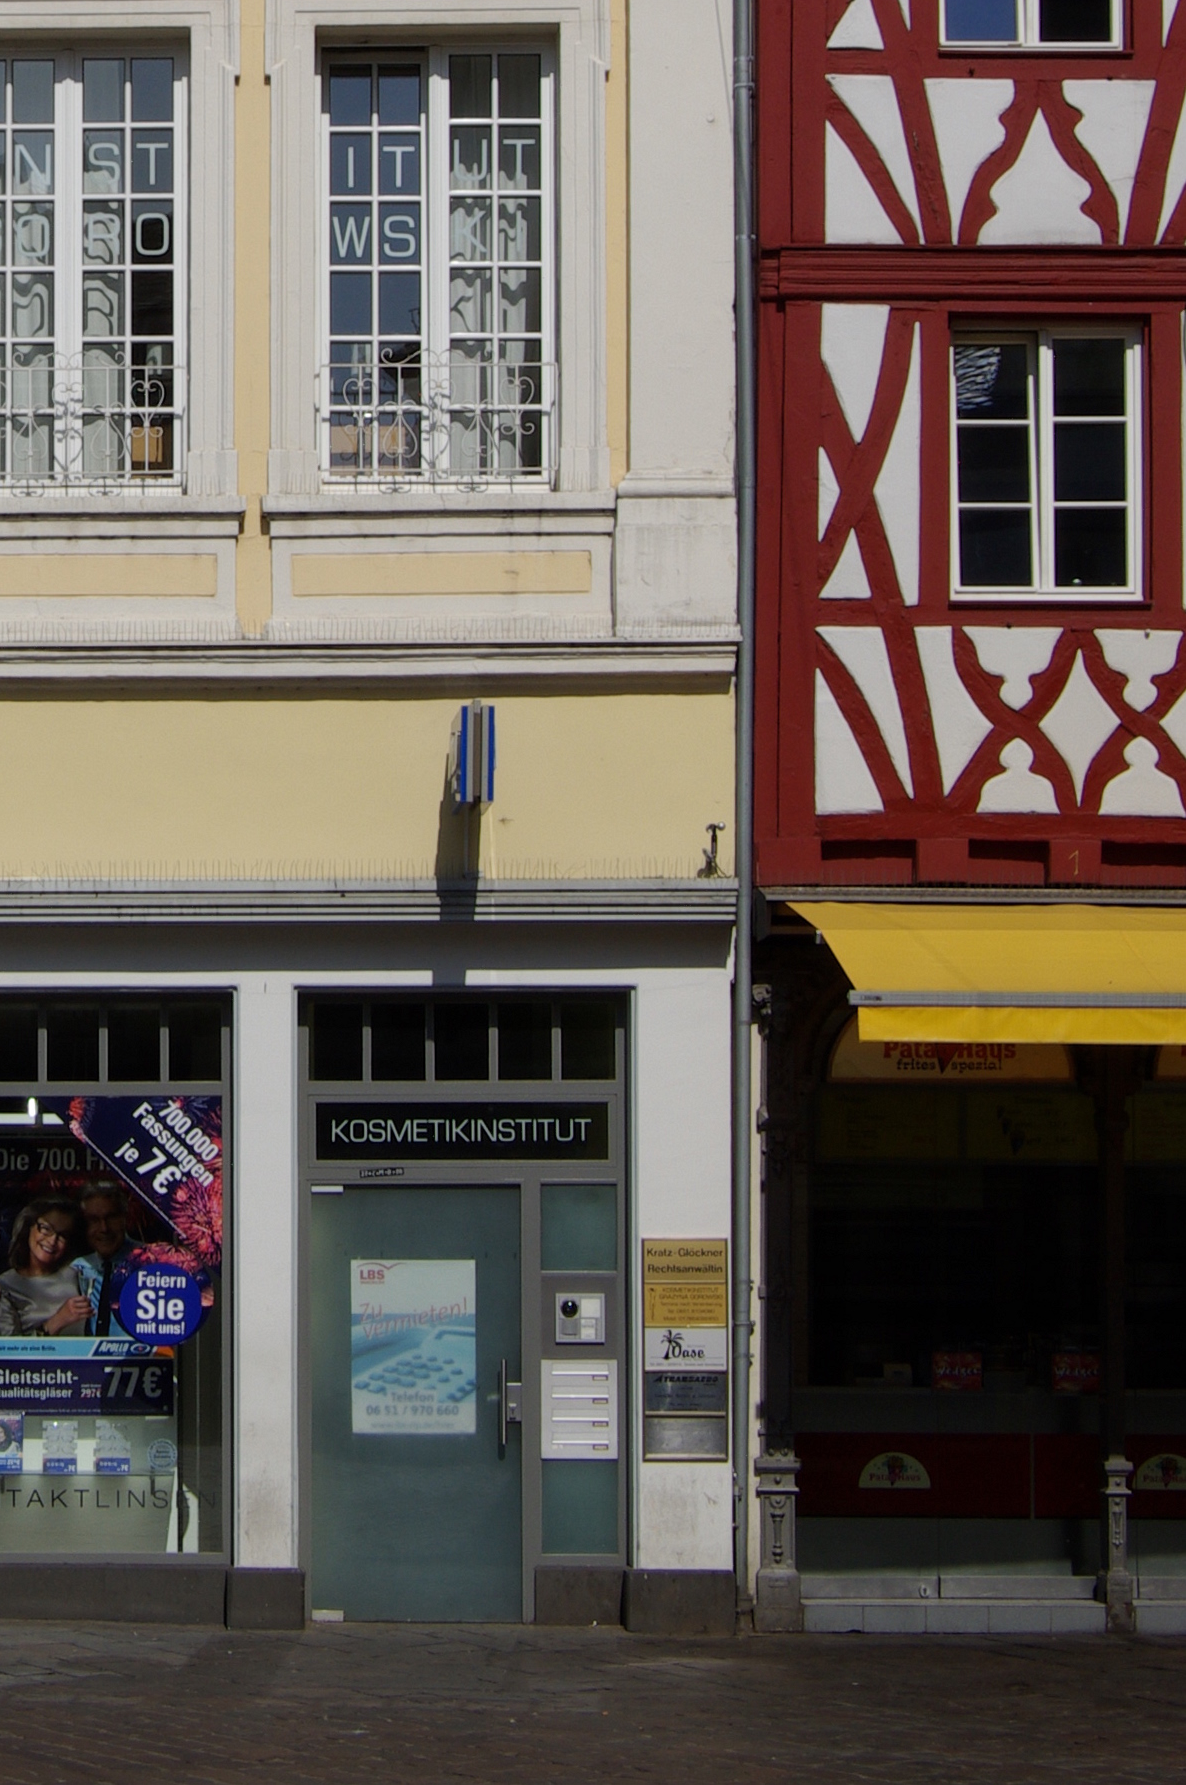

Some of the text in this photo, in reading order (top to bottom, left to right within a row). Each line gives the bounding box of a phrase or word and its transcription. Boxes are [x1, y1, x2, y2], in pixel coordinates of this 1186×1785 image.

[896, 1058, 936, 1071] frites
[158, 1099, 220, 1163] 700.000
[331, 1118, 592, 1143] KOSMETIKINSTITUT
[113, 1136, 140, 1164] je
[131, 1101, 214, 1188] Fassungen
[36, 1147, 81, 1171] 700.
[359, 1269, 385, 1281] LBS
[647, 1263, 723, 1273] Rechtsanwältin
[137, 1271, 187, 1289] Feiern
[135, 1289, 185, 1320] Sie
[135, 1320, 185, 1336] mit uns!
[362, 1296, 469, 1341] vermieten!
[390, 1390, 434, 1403] Telefon
[365, 1404, 381, 1415] 06
[410, 1404, 434, 1415] 970
[436, 1404, 460, 1415] 660
